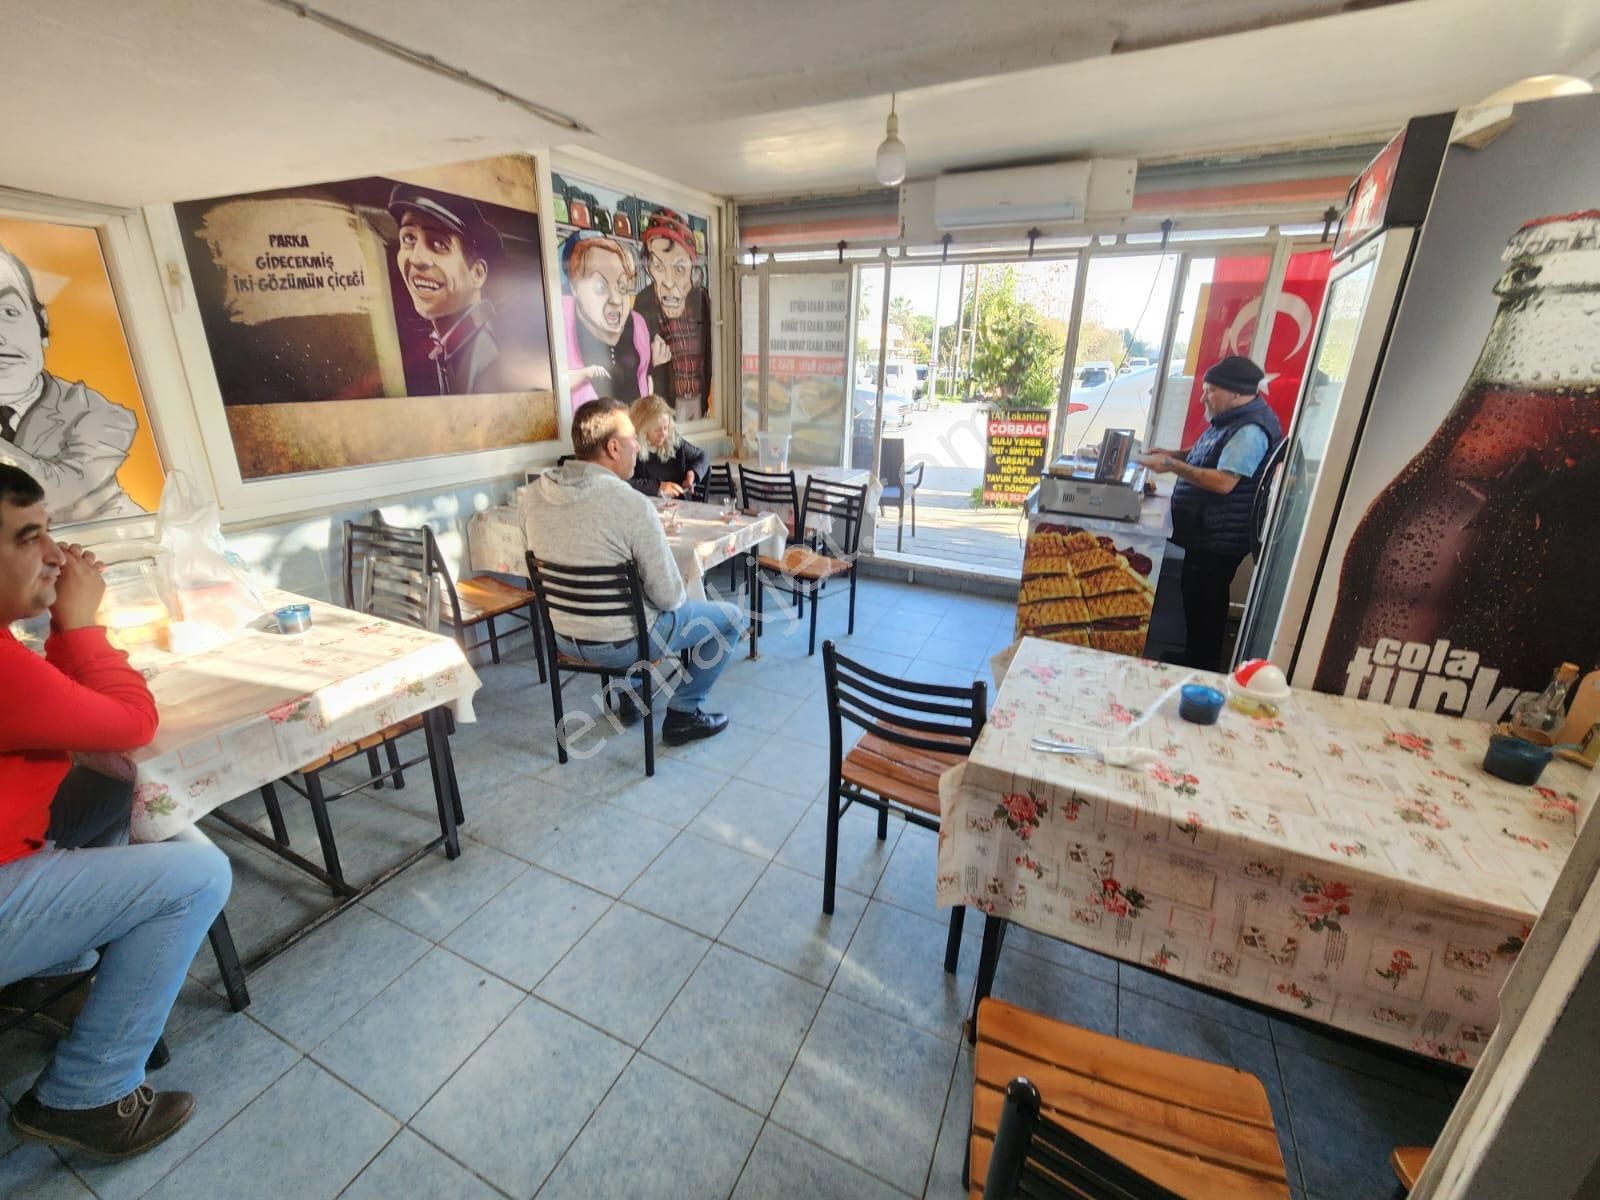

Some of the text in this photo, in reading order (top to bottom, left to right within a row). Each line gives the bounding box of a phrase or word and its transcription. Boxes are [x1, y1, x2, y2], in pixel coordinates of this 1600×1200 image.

[268, 233, 310, 248] PARKA
[255, 251, 335, 272] GİDECEKMİŞ
[232, 267, 366, 294] İKİ GÖZÜMÜN ÇİÇEĞİ
[989, 423, 1047, 436] ÇORBACI
[1014, 438, 1042, 447] YEMEK
[986, 475, 1012, 483] TAVUK
[1372, 637, 1481, 679] cola
